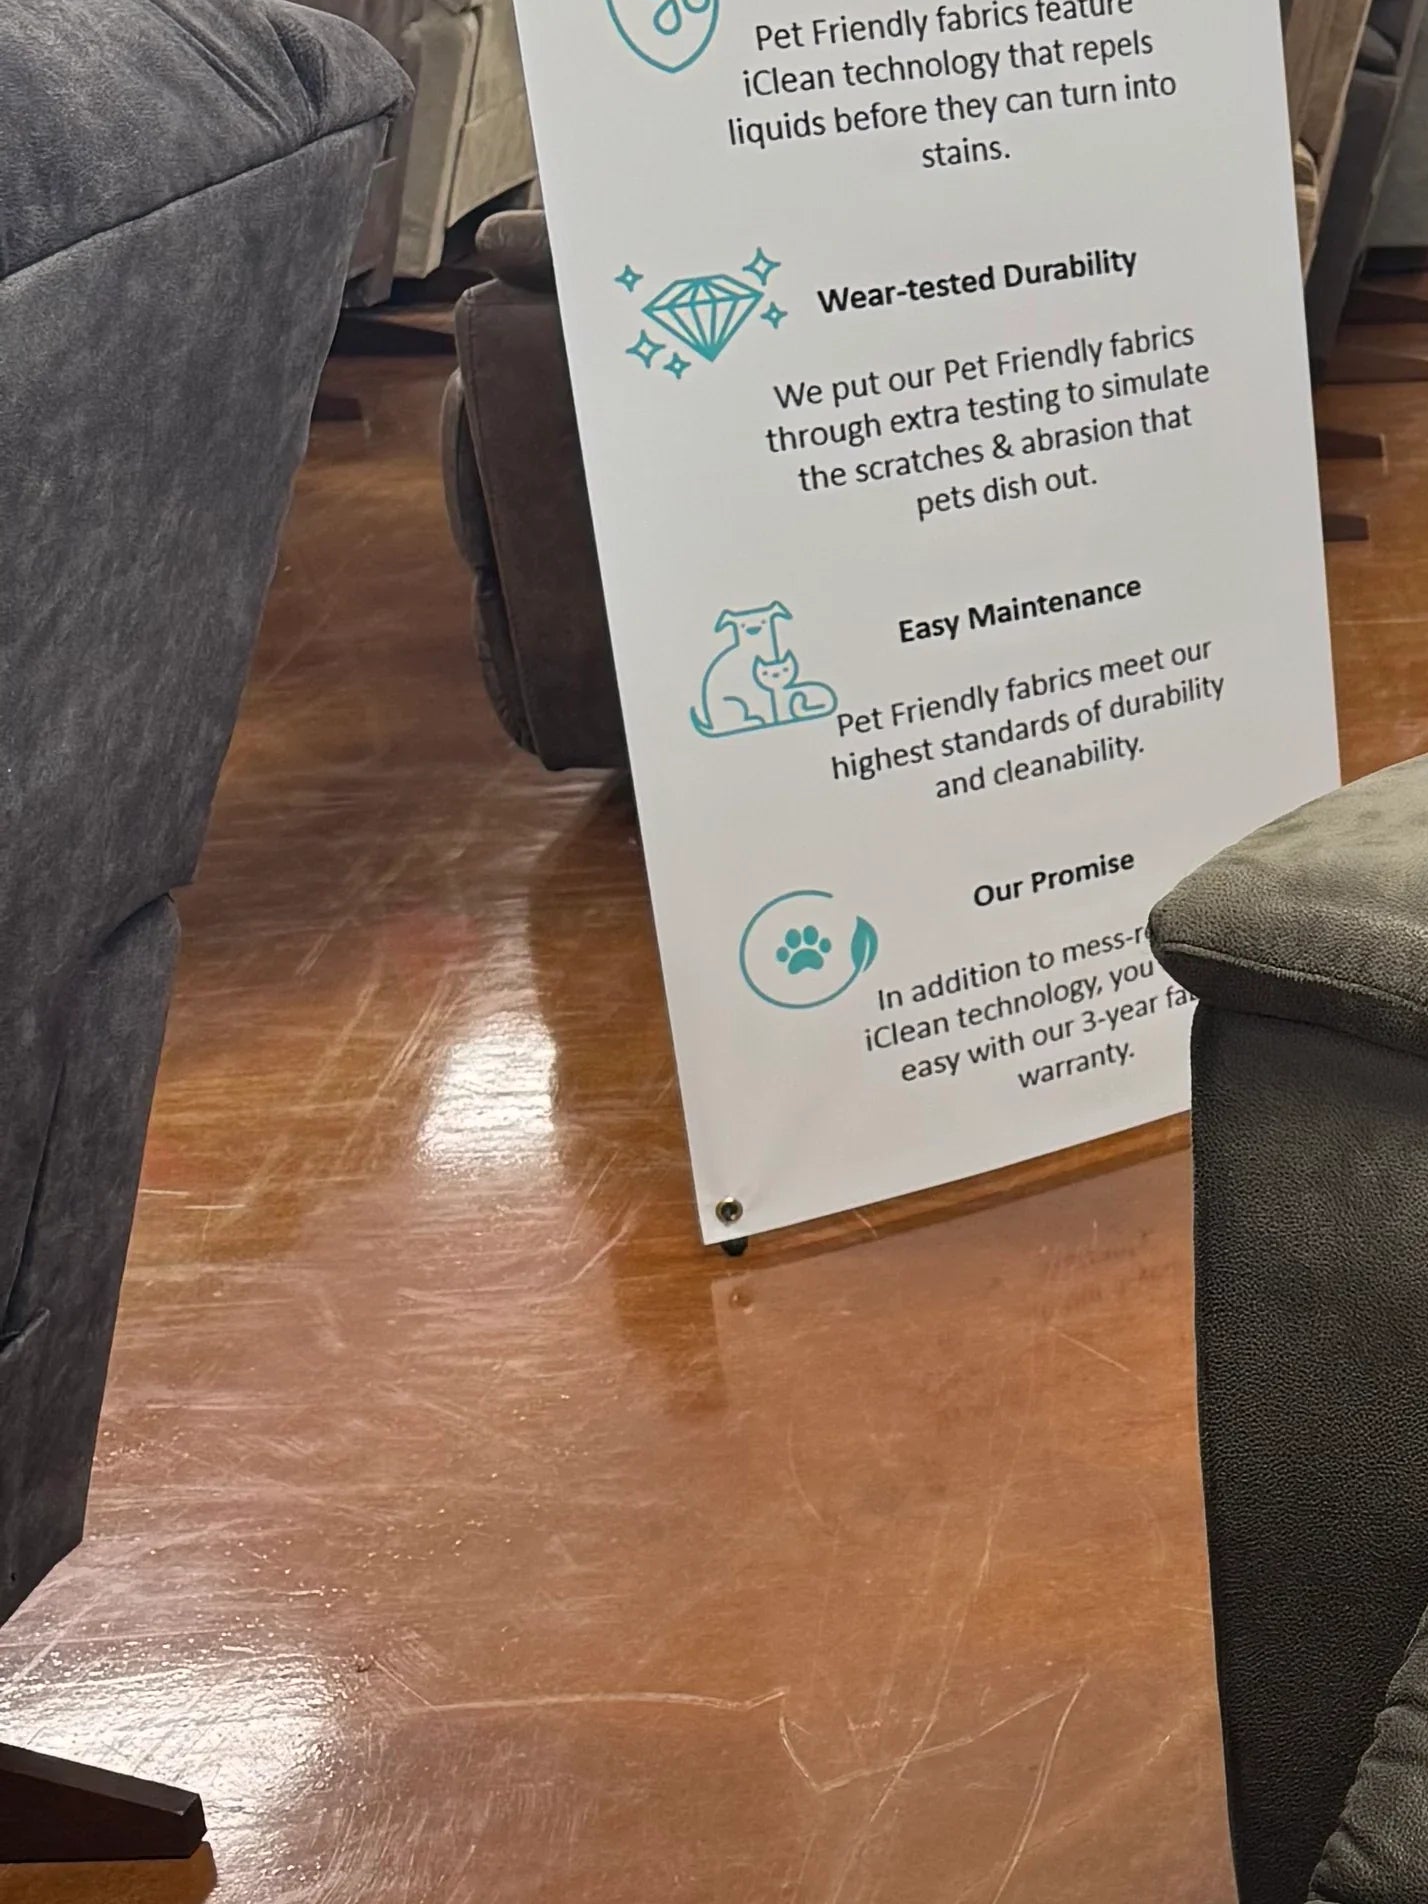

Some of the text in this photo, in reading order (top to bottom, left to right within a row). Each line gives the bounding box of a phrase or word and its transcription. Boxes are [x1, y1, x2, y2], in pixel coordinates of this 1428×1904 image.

[756, 22, 804, 50] Pet
[813, 10, 927, 45] Friendly
[936, 1, 1028, 32] fabrics
[743, 30, 1152, 97] iClean technology that repels
[729, 74, 1176, 149] liquids before they can turn into
[923, 138, 1010, 168] stains.
[817, 250, 1136, 313] Wear-tested Durability
[774, 325, 1194, 408] We put our Pet Friendly fabrics
[766, 363, 1208, 452] through extra testing to simulate
[798, 405, 1192, 491] the scratches & abrasion that
[917, 464, 1096, 521] pets dish out.
[899, 580, 1141, 643] Easy Maintenance
[837, 642, 1211, 736] Pet Friendly fabrics meet our
[832, 677, 1224, 780] highest standards of durability
[936, 737, 1144, 798] and cleanability.
[974, 854, 1134, 906] Our Promise
[865, 961, 1153, 1051] iClean technology, you
[879, 990, 902, 1010] In
[912, 961, 1020, 1002] addition
[1028, 952, 1054, 971] to
[902, 1052, 960, 1081] easy
[968, 1032, 1024, 1063] with
[1033, 1020, 1073, 1046] our
[1082, 997, 1157, 1032] 3-year
[1018, 1043, 1134, 1088] warranty.
